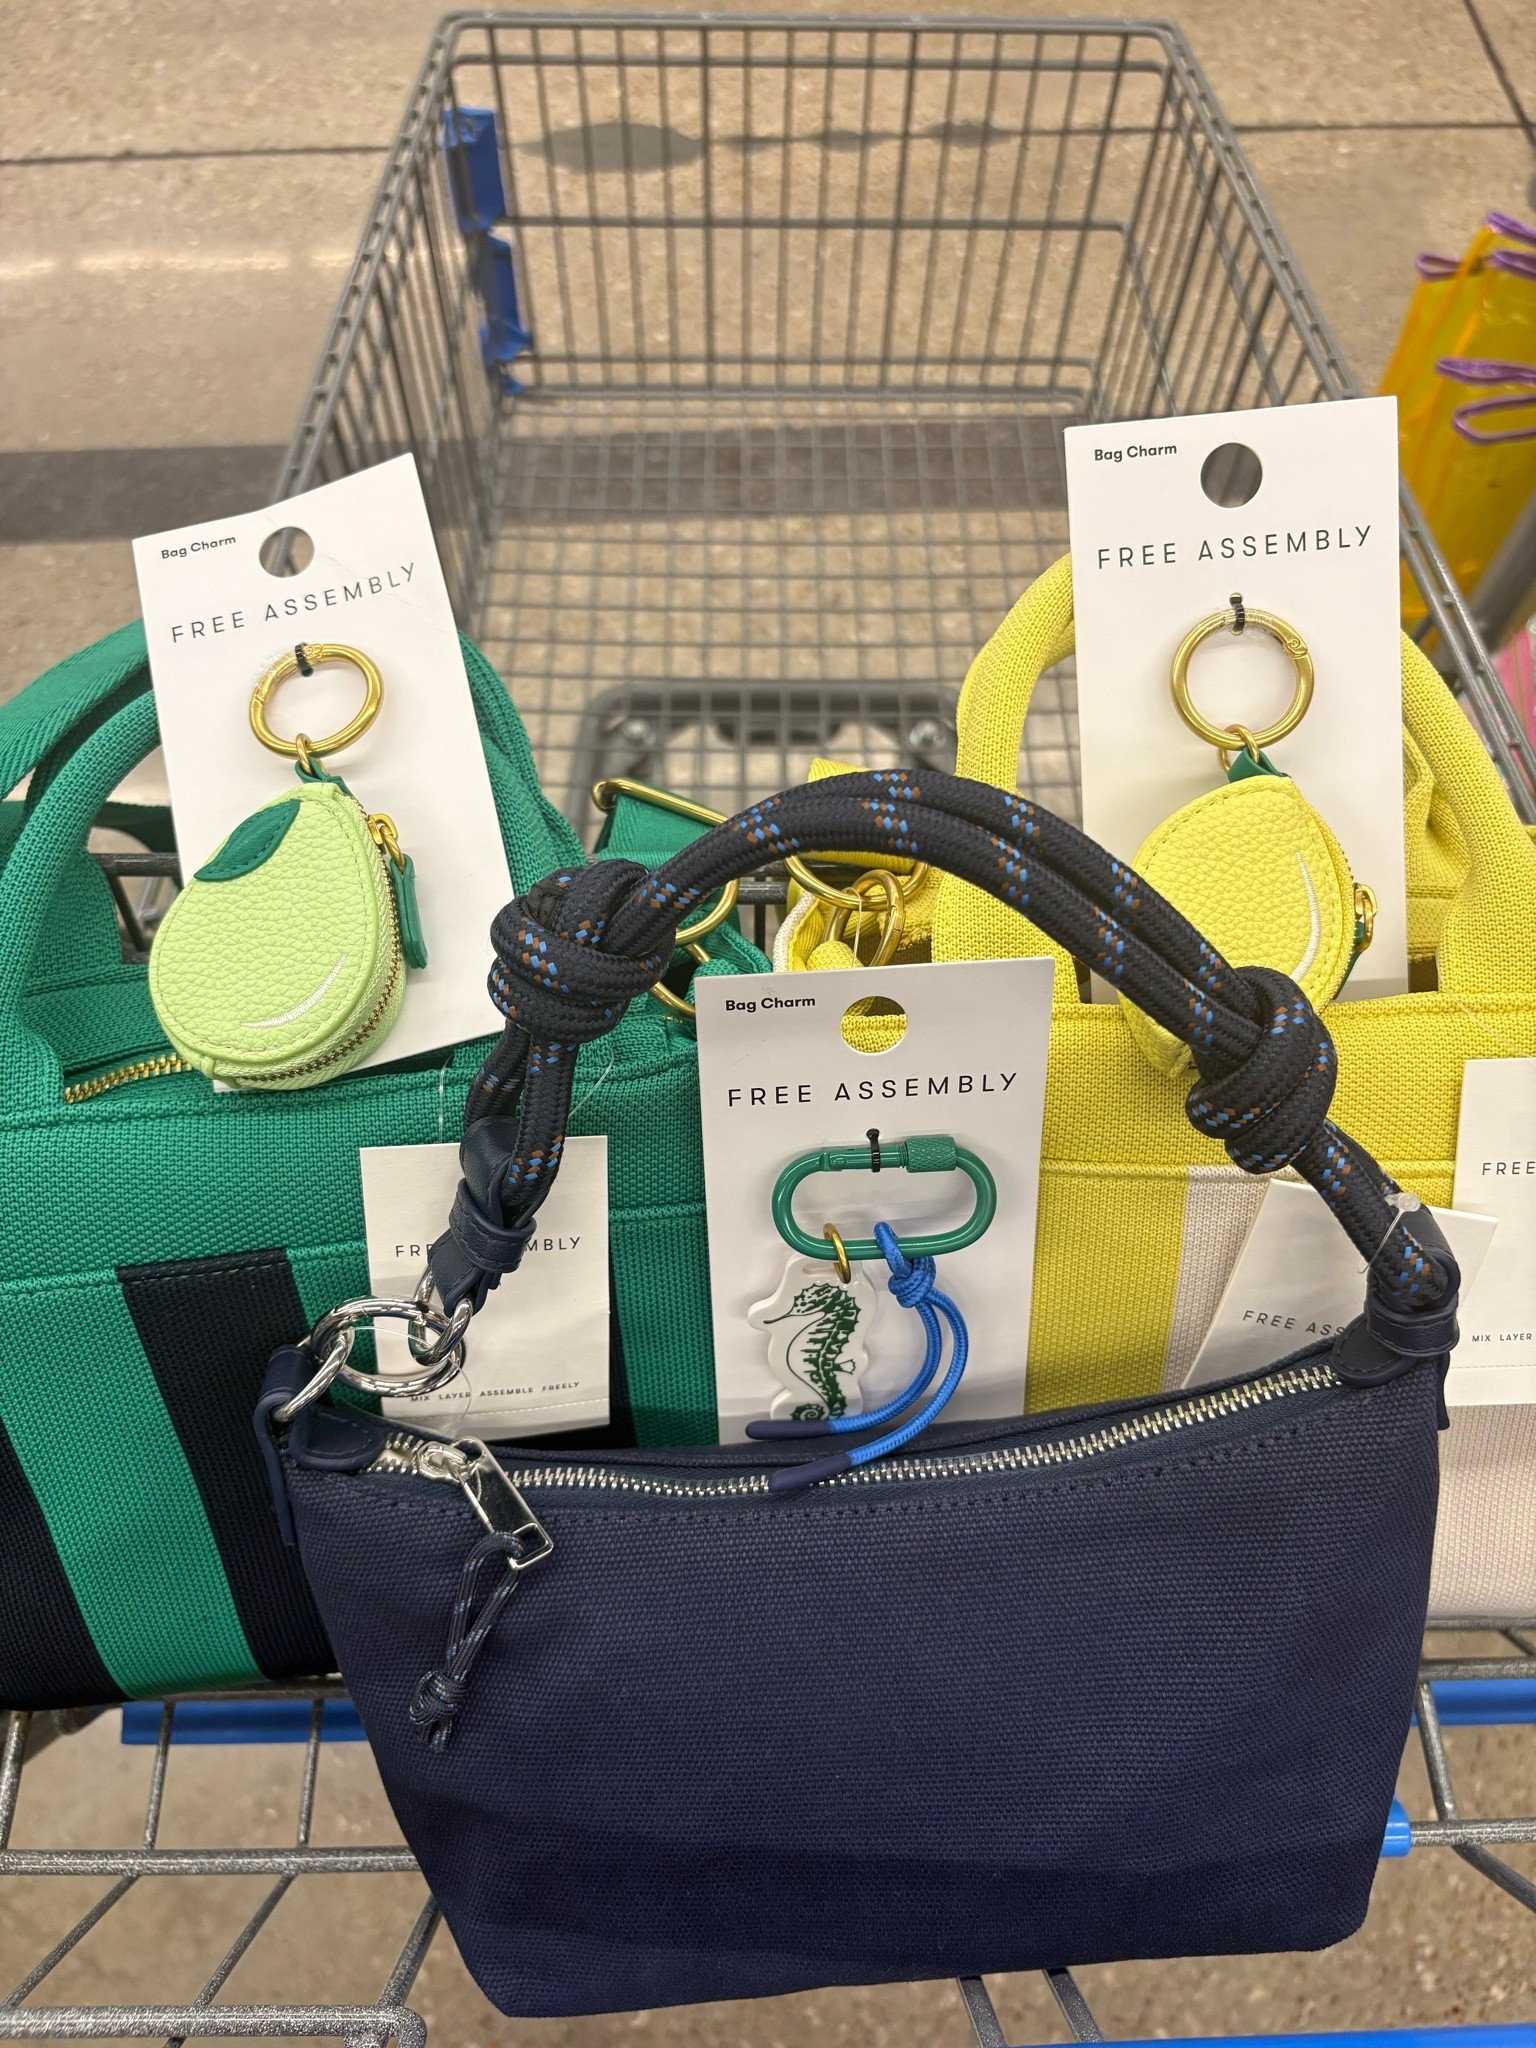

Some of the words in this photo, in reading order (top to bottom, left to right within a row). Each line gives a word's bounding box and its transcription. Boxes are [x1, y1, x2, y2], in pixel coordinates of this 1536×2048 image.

[1094, 449, 1123, 462] Bag
[1126, 443, 1178, 458] Charm
[161, 548, 188, 559] Bag
[190, 536, 237, 552] Charm
[1098, 542, 1177, 570] FREE
[1198, 525, 1372, 561] ASSEMBLY
[171, 611, 245, 643] FREE
[264, 562, 414, 622] ASSEMBLY
[725, 999, 757, 1013] Bag
[760, 996, 817, 1010] Charm
[728, 1084, 812, 1107] FREE
[834, 1072, 1017, 1101] ASSEMBLY
[1482, 1161, 1536, 1175] FREE
[395, 1243, 434, 1257] FR
[1242, 1310, 1296, 1330] FREE
[1472, 1334, 1491, 1342] MIX
[1499, 1333, 1533, 1341] LAYER
[439, 1392, 472, 1400] LAYER
[480, 1386, 534, 1397] ASSEMBLE
[542, 1381, 580, 1392] FREELY
